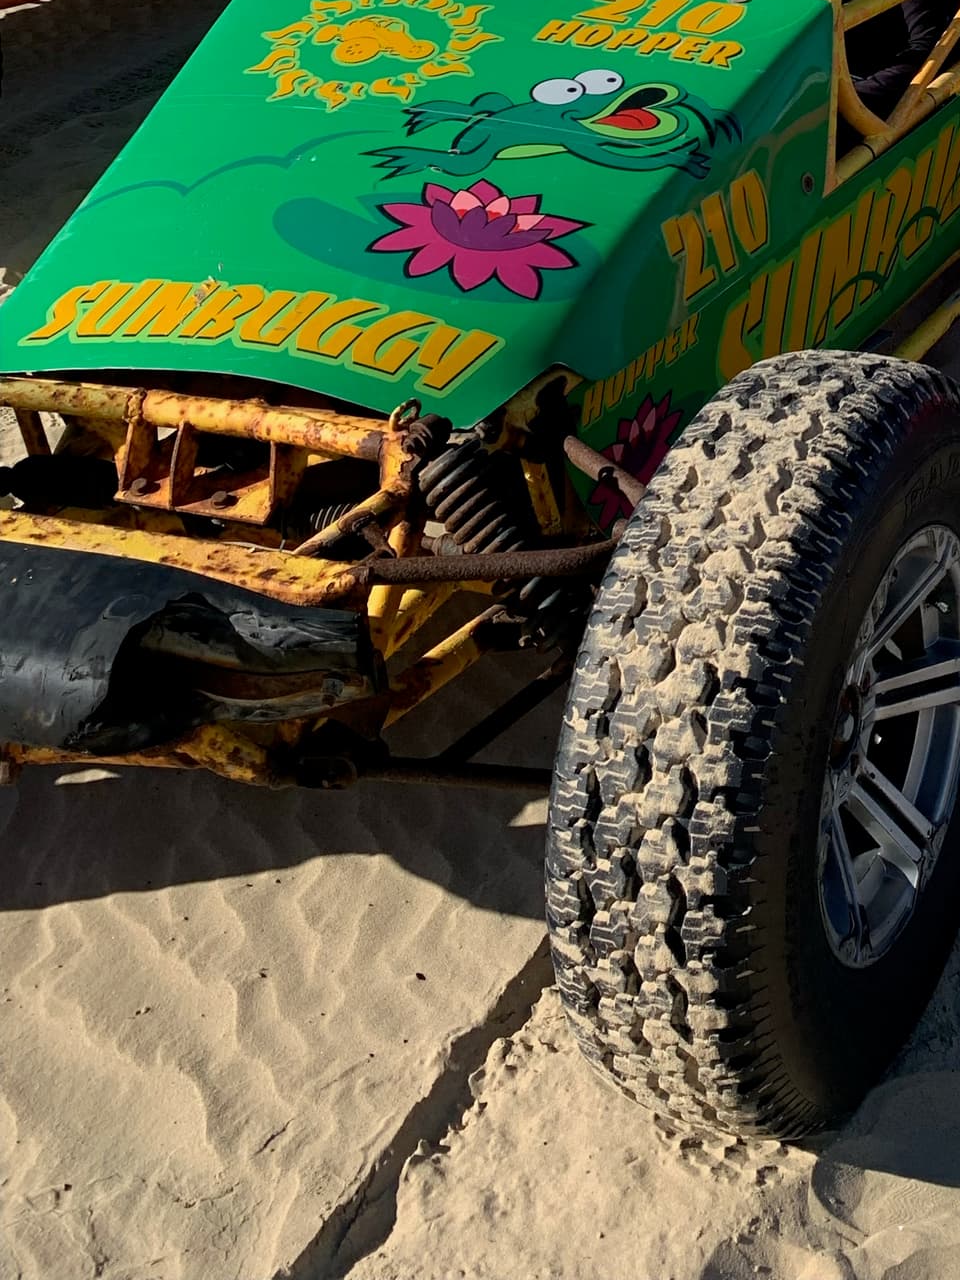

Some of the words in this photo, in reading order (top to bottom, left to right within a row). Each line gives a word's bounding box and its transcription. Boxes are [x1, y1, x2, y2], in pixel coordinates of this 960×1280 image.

[534, 18, 745, 69] HOPPER
[662, 170, 770, 306] 210
[22, 280, 504, 394] SUNBUGGY
[582, 314, 700, 429] HOPPER
